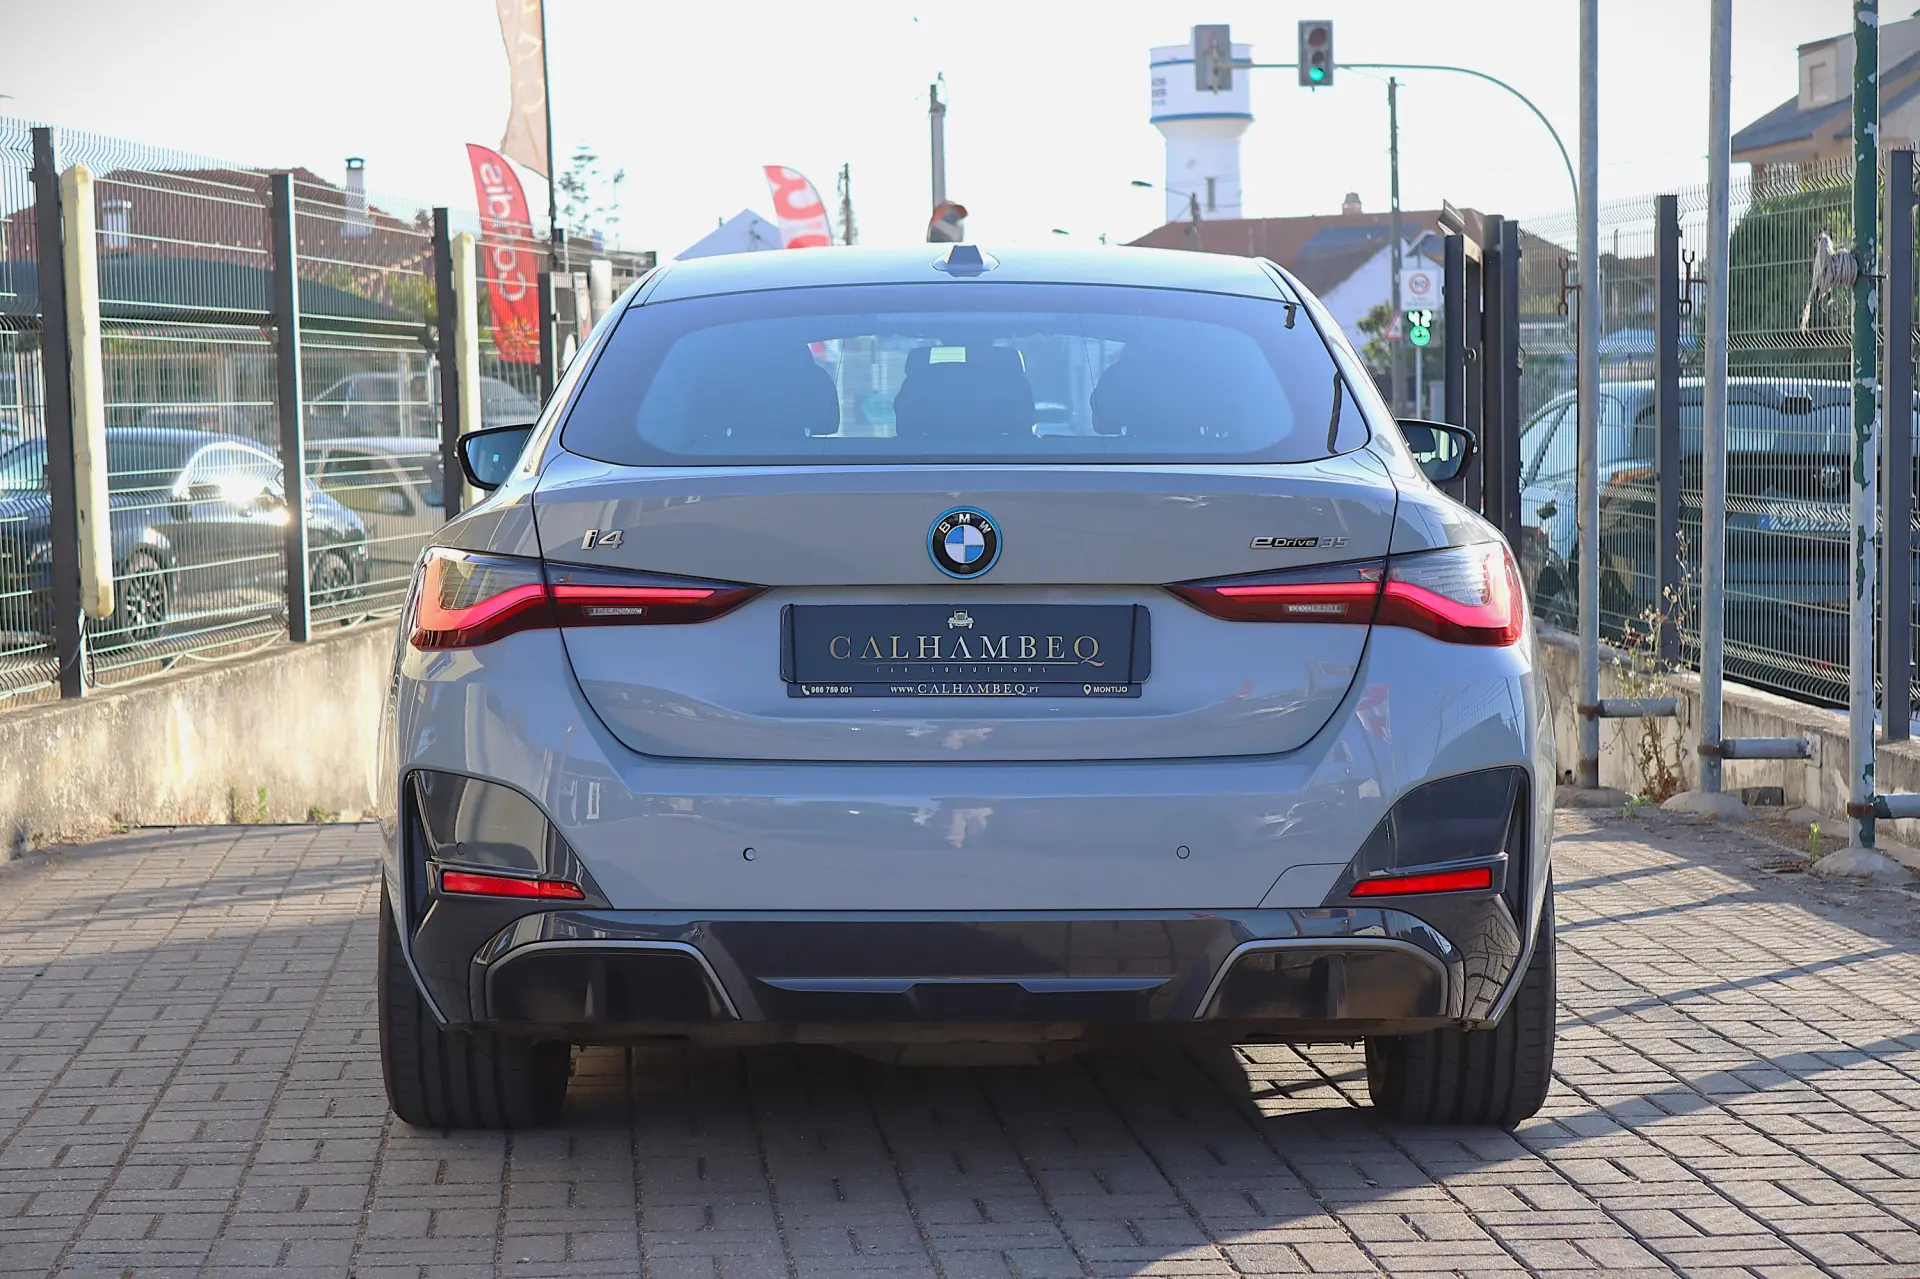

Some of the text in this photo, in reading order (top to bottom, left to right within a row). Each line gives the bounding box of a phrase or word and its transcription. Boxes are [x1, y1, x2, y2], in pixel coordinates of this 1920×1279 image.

[938, 513, 992, 534] BMW
[581, 529, 624, 549] i4
[829, 635, 1106, 667] CALHAMBEQ
